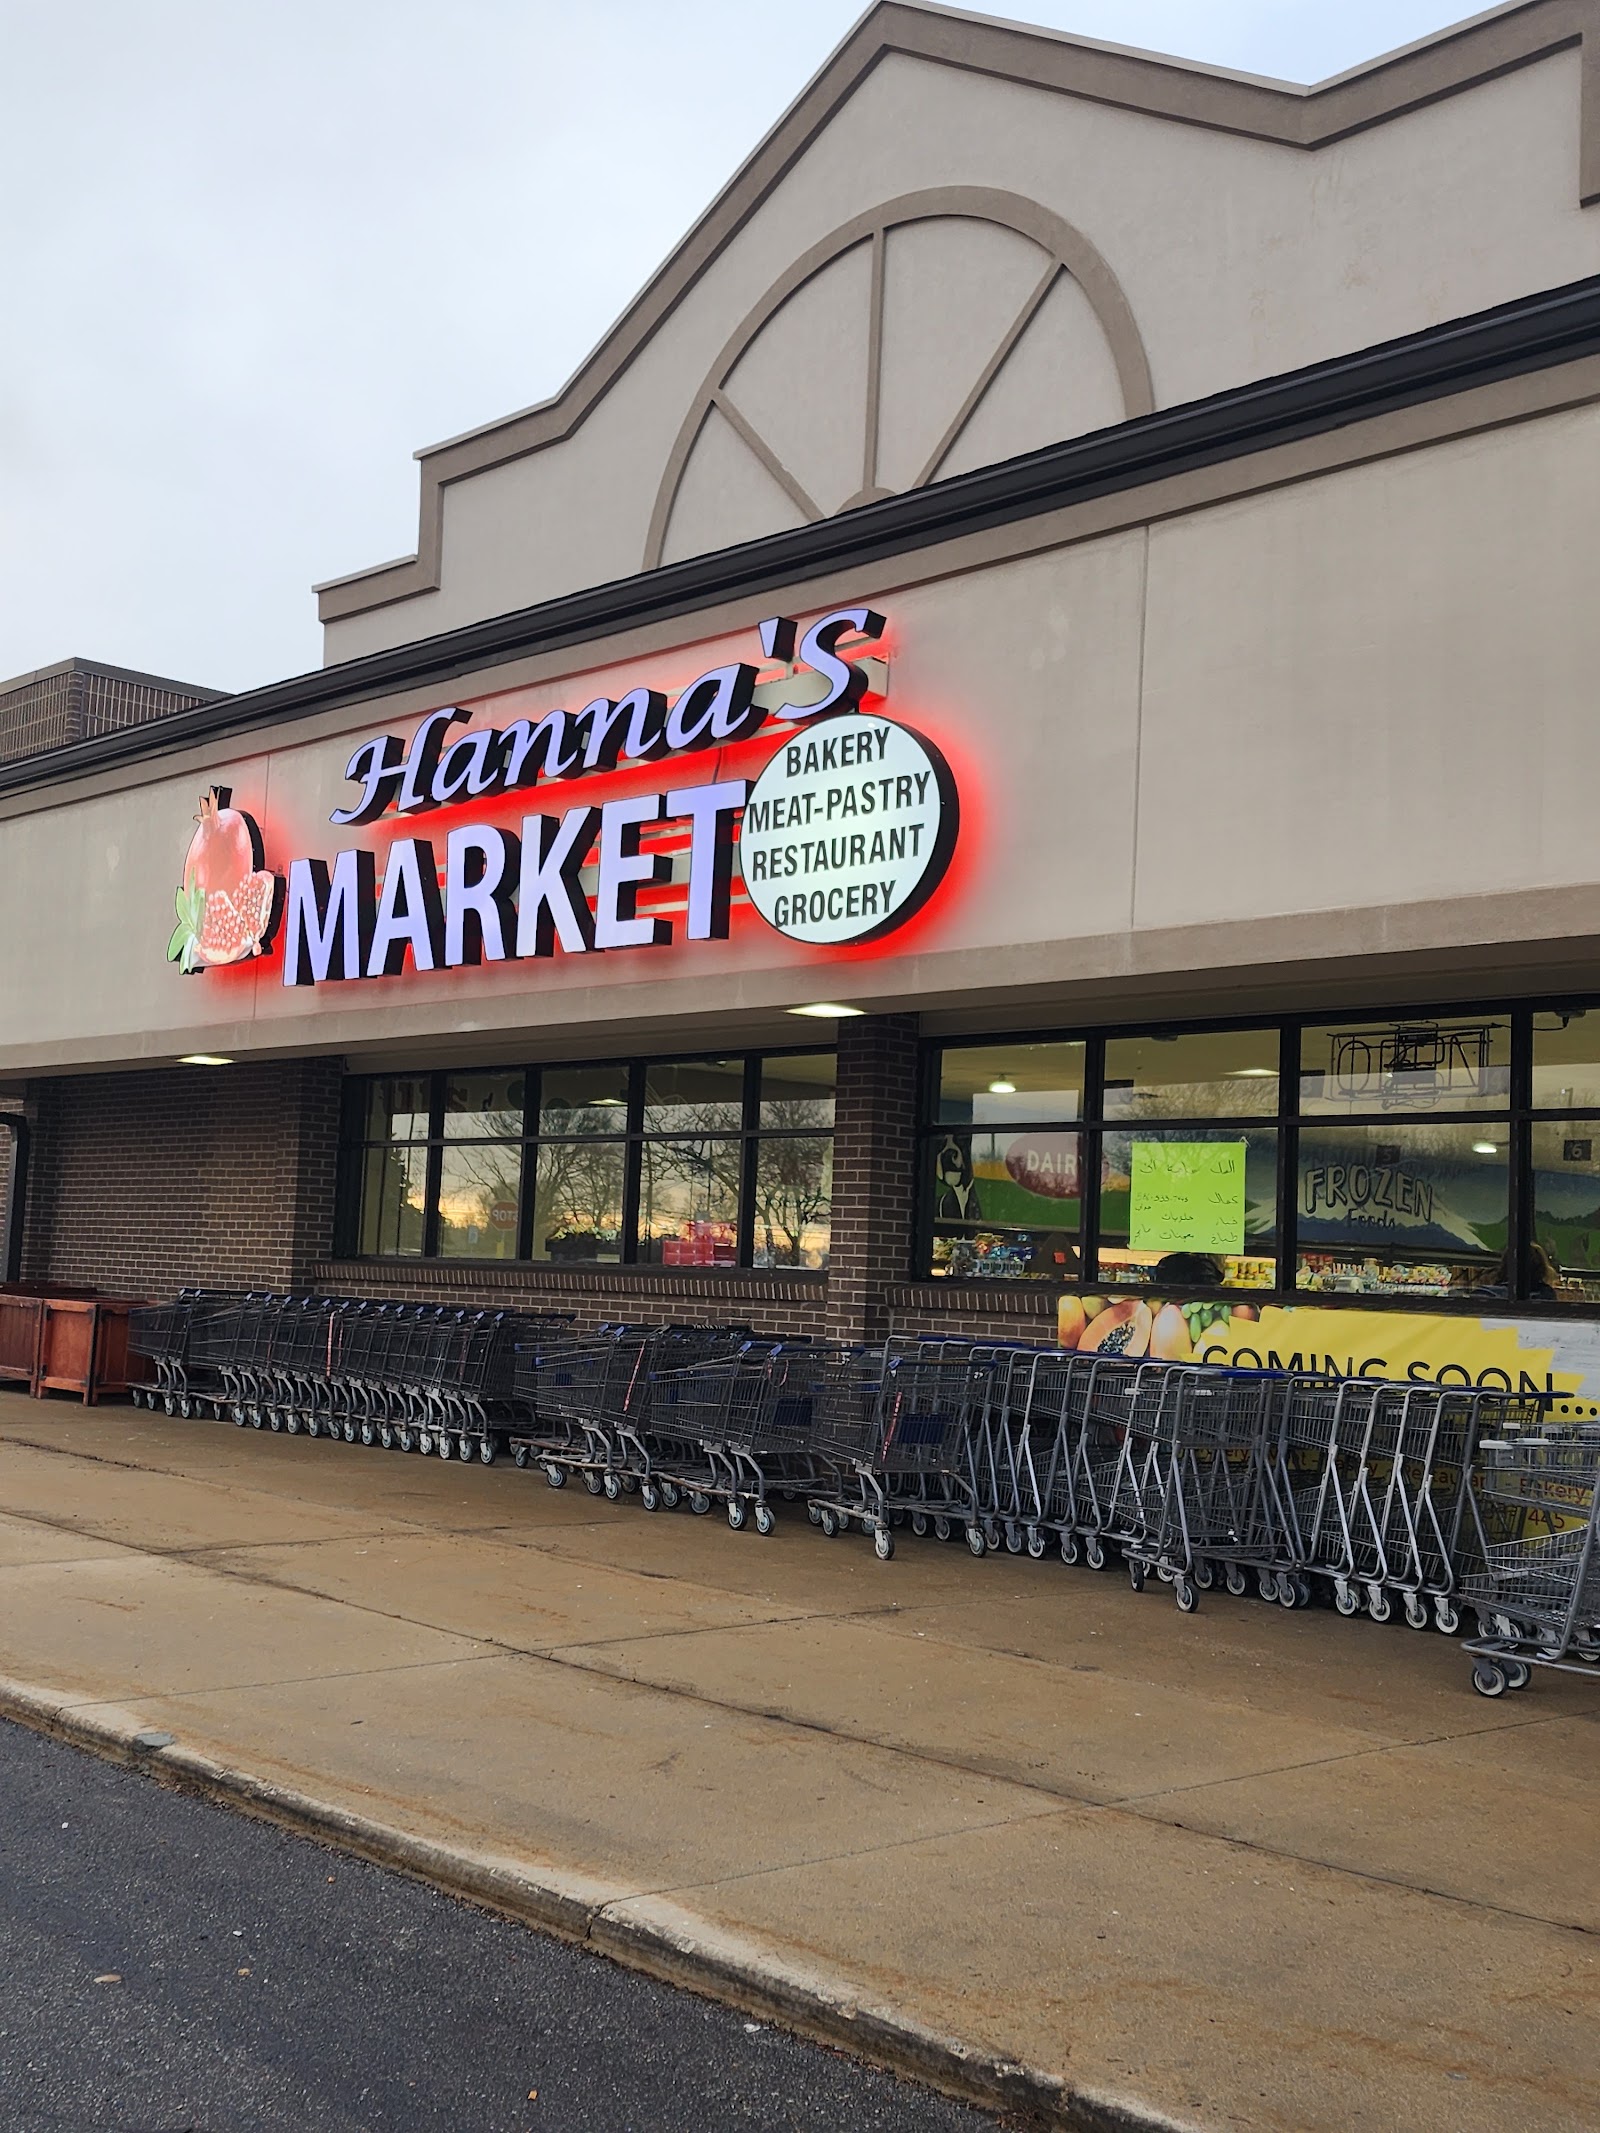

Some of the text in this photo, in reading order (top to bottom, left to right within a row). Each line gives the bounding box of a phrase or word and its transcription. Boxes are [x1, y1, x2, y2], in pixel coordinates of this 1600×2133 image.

[786, 726, 892, 779] BAKERY
[749, 771, 932, 834] MEAT-PASTRY
[751, 823, 926, 882] RESTAURANT
[283, 779, 753, 986] MARKET
[774, 879, 897, 928] GROCERY
[1026, 1149, 1082, 1175] DAIR
[1304, 1164, 1434, 1224] FROZEN
